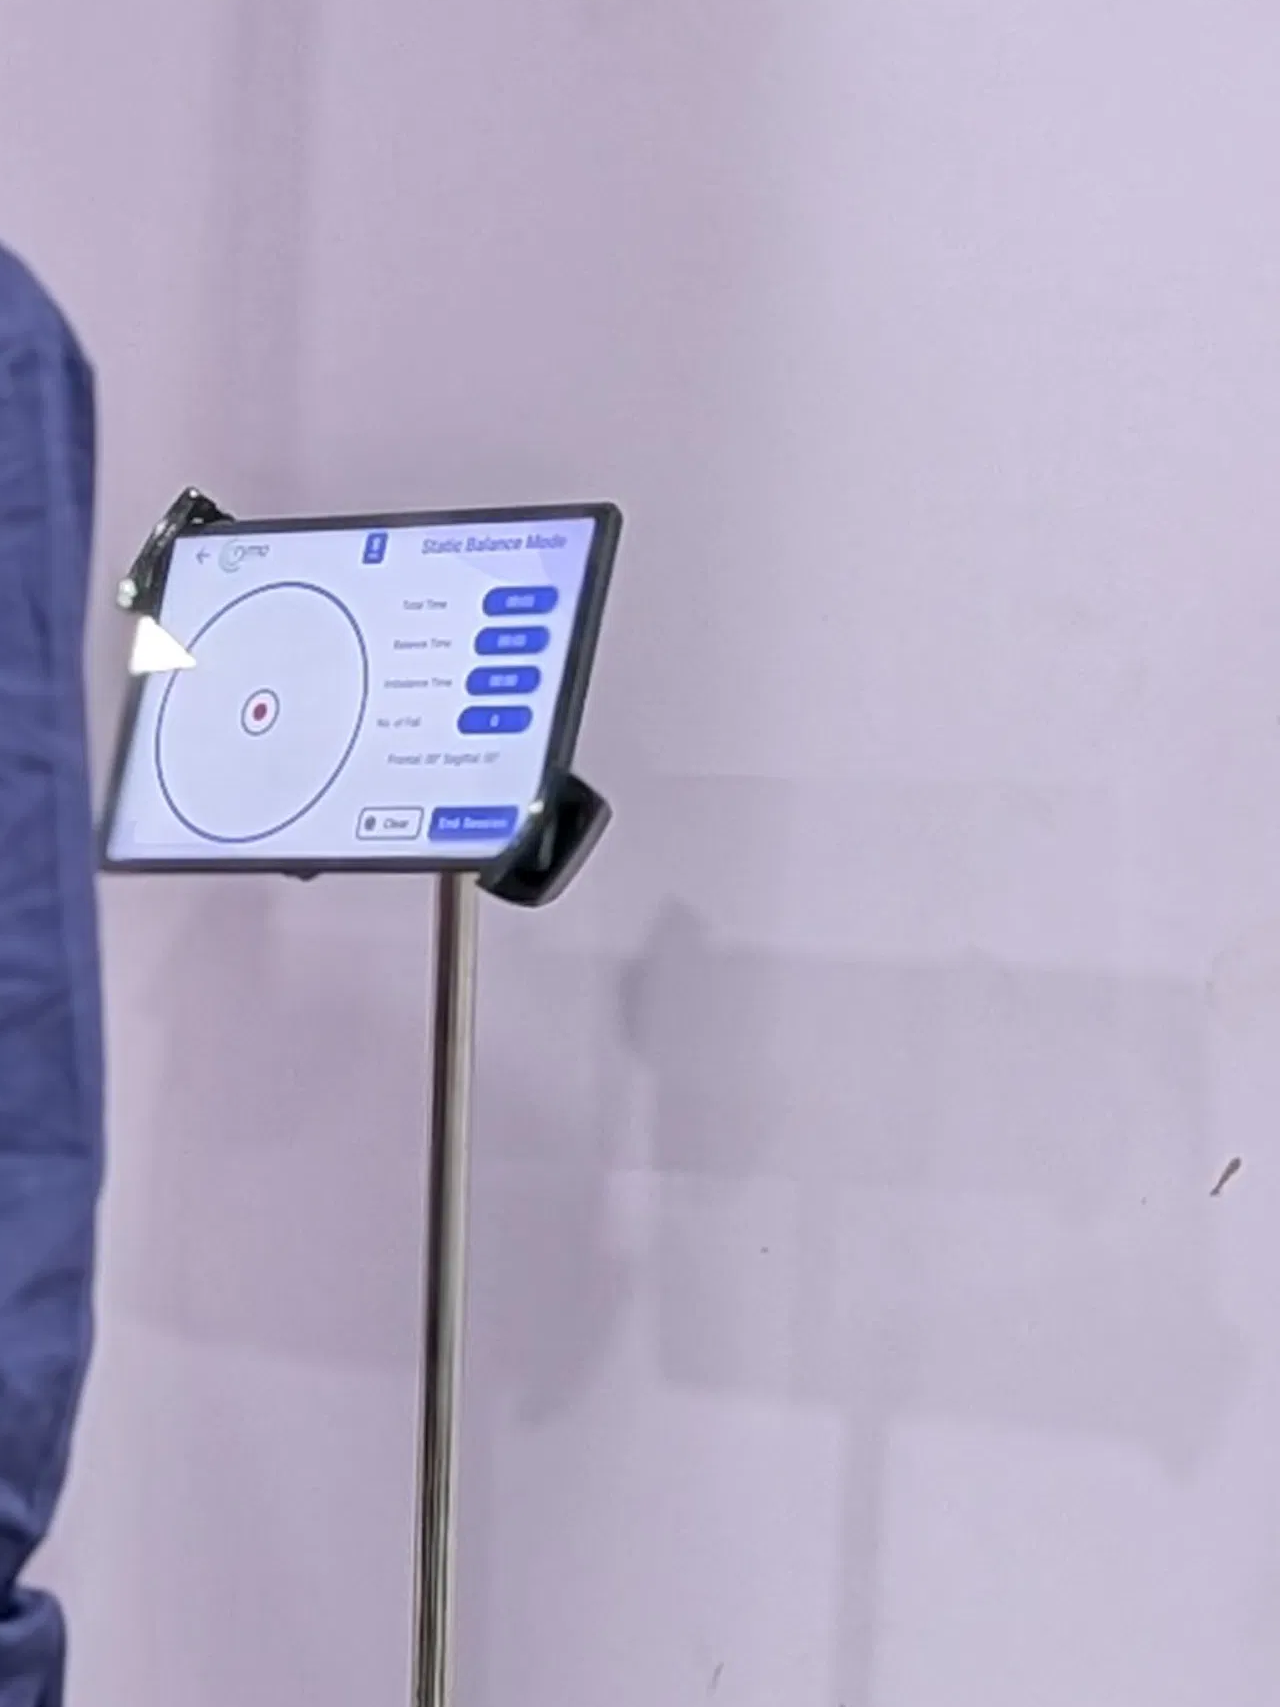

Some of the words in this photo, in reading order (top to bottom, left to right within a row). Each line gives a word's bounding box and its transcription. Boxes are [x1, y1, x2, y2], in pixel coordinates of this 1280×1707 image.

[422, 537, 462, 554] Static
[465, 535, 523, 553] Balance
[526, 533, 568, 550] Mode
[383, 817, 410, 830] Clear
[438, 817, 460, 830] End
